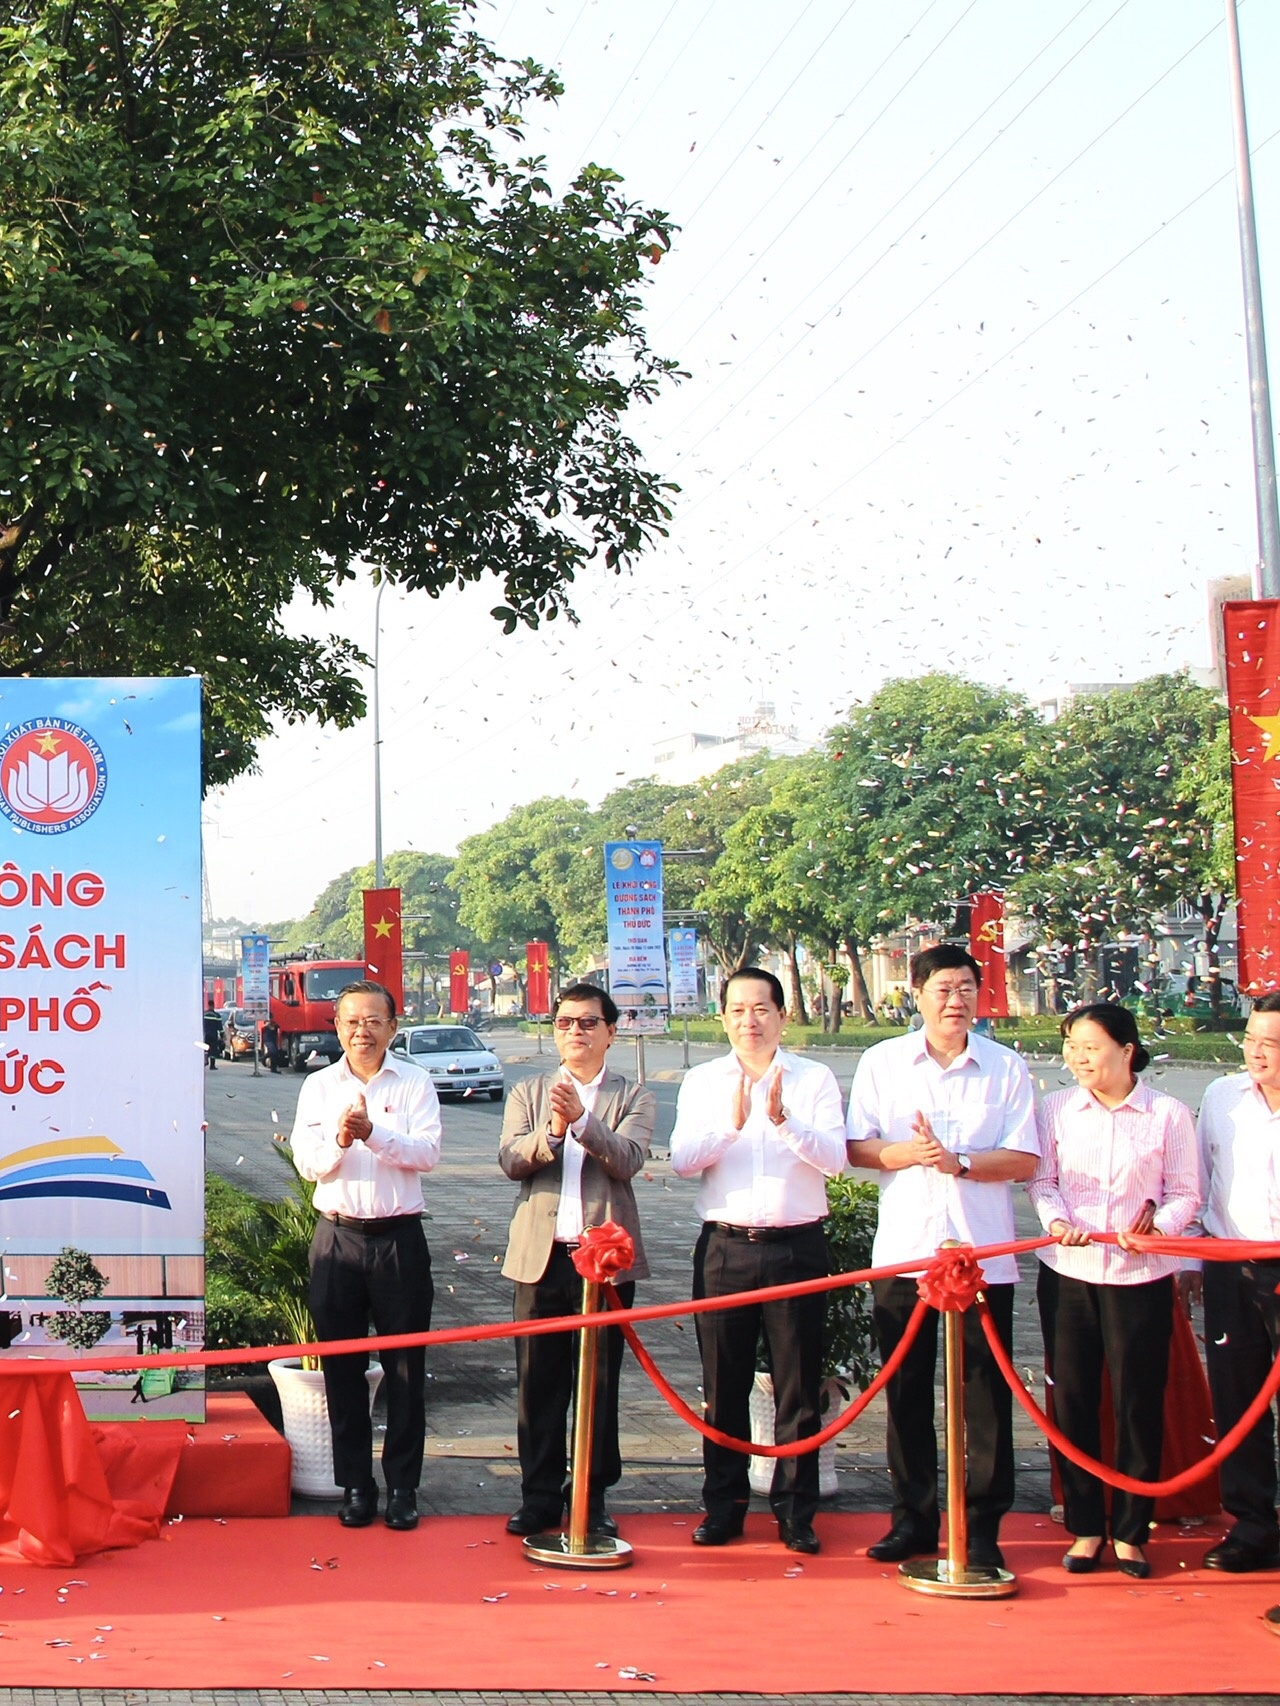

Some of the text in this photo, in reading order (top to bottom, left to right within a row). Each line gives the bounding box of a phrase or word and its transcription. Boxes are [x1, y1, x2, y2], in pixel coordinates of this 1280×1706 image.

[8, 721, 33, 744] XUẤT
[36, 717, 60, 728] BẢN
[64, 720, 88, 740] VIỆT
[85, 739, 104, 764] NAM
[9, 813, 68, 834] PUBLISHERS
[69, 774, 107, 829] ASSOCIATION
